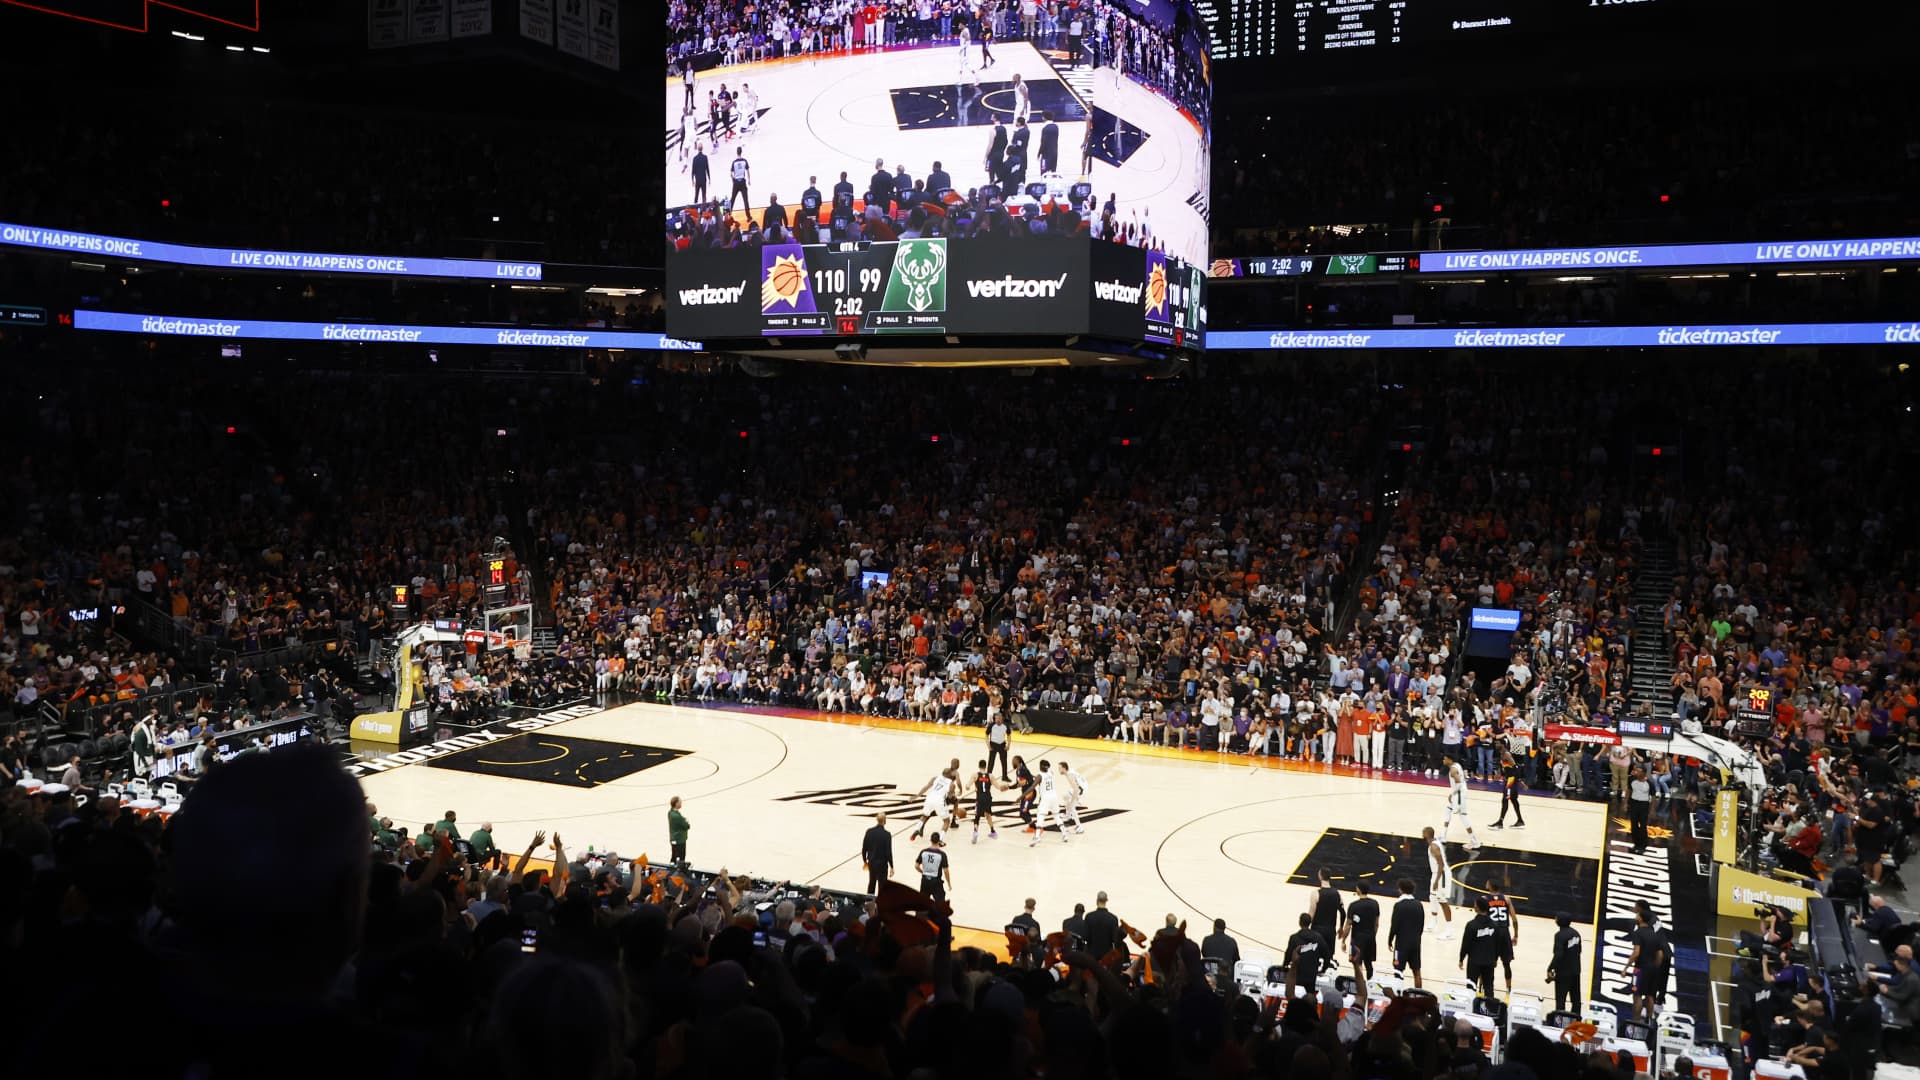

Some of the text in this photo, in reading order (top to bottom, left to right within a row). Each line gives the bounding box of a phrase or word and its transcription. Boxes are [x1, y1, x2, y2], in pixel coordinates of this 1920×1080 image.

[4, 227, 143, 255] ONLY HAPPENS ONCE.
[855, 243, 859, 251] 4
[1445, 250, 1642, 268] LIVE ONLY HAPPENS ONCE.
[1756, 244, 1794, 259] LIVE
[1796, 243, 1843, 258] ONLY
[231, 252, 408, 272] LIVE ONLY HAPPENS ONCE.
[497, 264, 524, 277] LIVE
[1249, 258, 1312, 274] 110 2:02 99
[1409, 258, 1419, 269] 14
[814, 268, 882, 294] 110 99
[966, 275, 1057, 298] verizon
[679, 283, 738, 306] verizon
[1094, 279, 1139, 305] verizon
[835, 298, 863, 316] 2:02
[58, 313, 71, 325] 14
[141, 316, 241, 336] ticketmaster
[792, 317, 797, 325] 2
[820, 317, 826, 325] 2
[841, 320, 854, 331] 14
[908, 316, 913, 324] 2
[322, 323, 422, 341] ticketmaster
[497, 330, 589, 347] ticketmaster
[1270, 331, 1371, 348] ticketmaster
[1454, 330, 1565, 347] ticketmaster
[1657, 327, 1781, 345] ticketmaster
[492, 571, 502, 584] 14
[1752, 699, 1765, 711] 14
[507, 704, 605, 731] SUNS
[1662, 726, 1671, 735] TV
[982, 781, 986, 792] 1
[1045, 782, 1053, 791] 21
[1720, 793, 1731, 838] NBA TV
[1606, 839, 1674, 930] PHOENIX
[1773, 894, 1803, 912] game
[1488, 906, 1507, 921] 25
